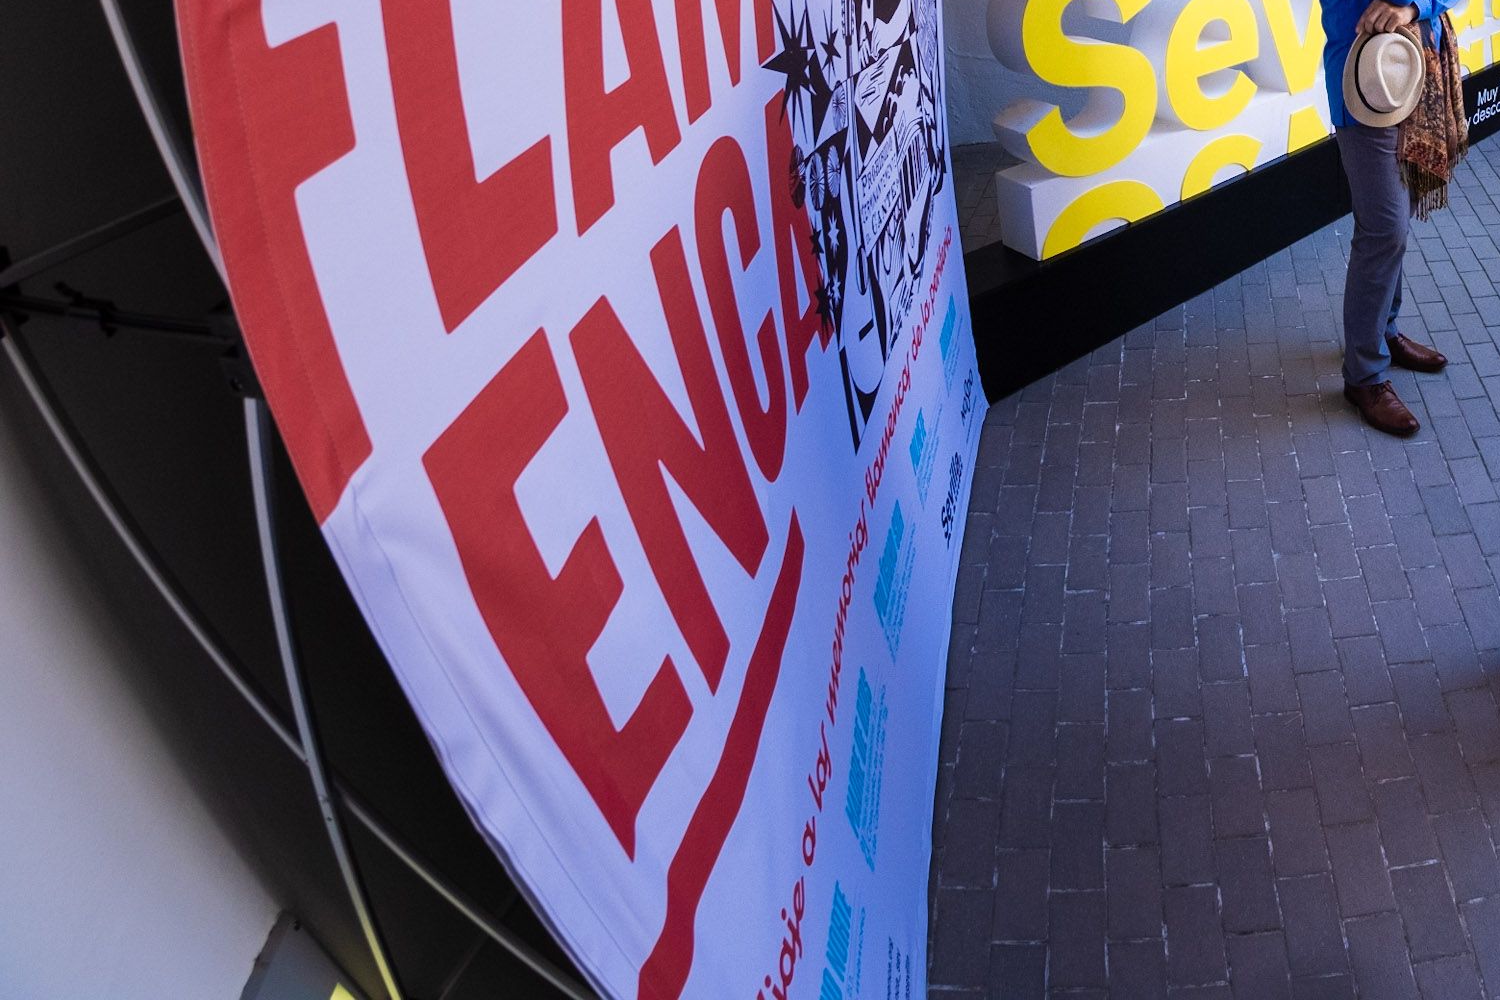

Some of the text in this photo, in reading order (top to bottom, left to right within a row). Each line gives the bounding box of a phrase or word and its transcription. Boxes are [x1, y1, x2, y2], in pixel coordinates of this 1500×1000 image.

[1463, 115, 1471, 133] y
[1477, 87, 1499, 107] Muy
[911, 324, 923, 361] de
[920, 299, 931, 331] la
[865, 350, 911, 508] flamencas
[826, 498, 869, 726] memorias
[808, 720, 832, 812] las
[802, 818, 816, 867] a
[756, 875, 805, 1000] iaje
[826, 880, 851, 982] NORTE
